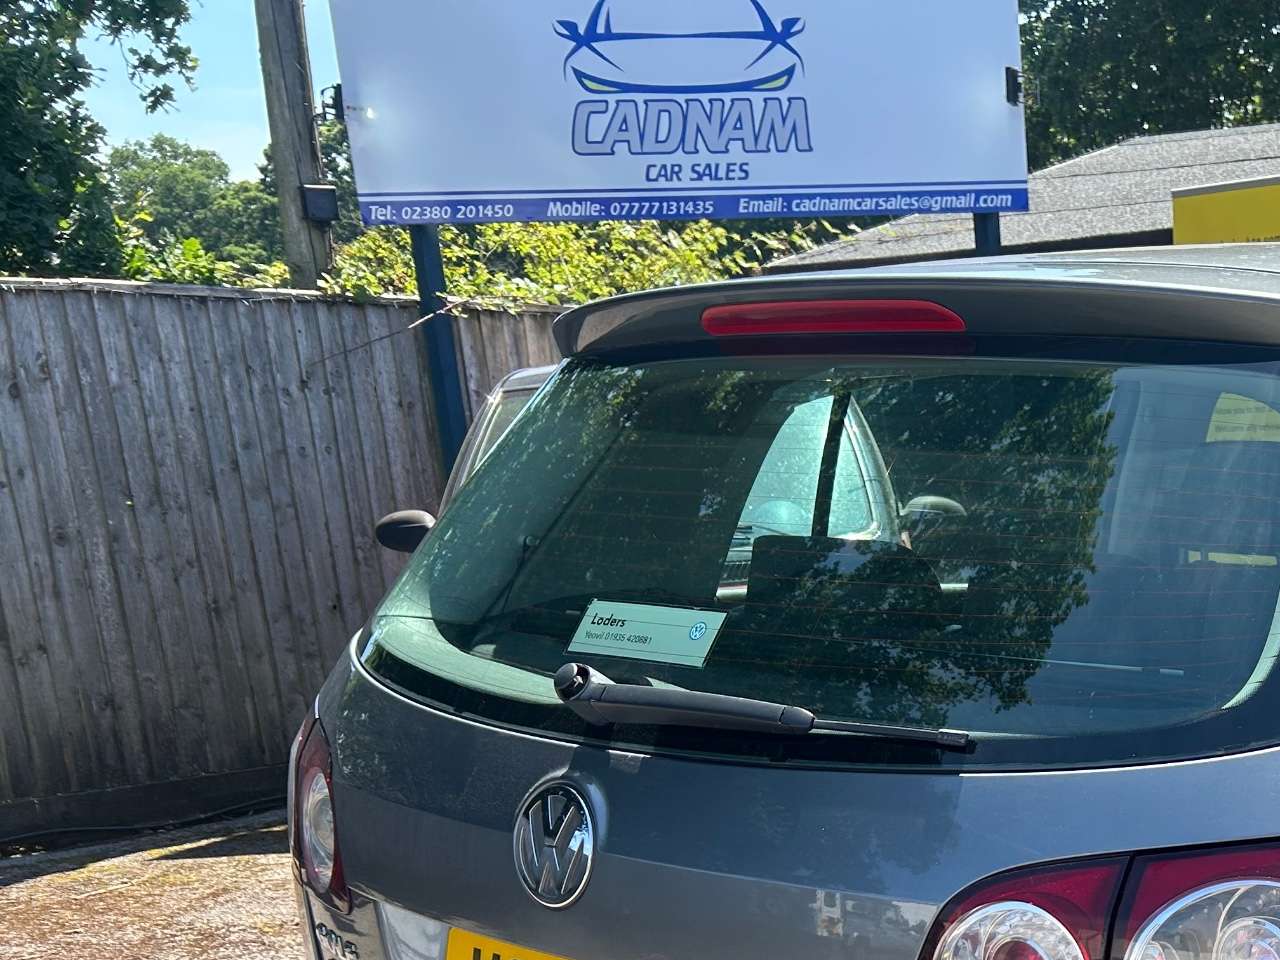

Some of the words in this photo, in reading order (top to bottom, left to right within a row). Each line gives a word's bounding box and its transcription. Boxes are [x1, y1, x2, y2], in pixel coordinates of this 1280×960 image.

[572, 97, 813, 156] CADNAM
[645, 164, 682, 182] CAR
[689, 162, 750, 181] SALES
[369, 205, 397, 220] Tel:
[401, 206, 451, 219] 02380
[456, 204, 514, 218] 201450
[547, 201, 606, 217] Mobile:
[610, 200, 714, 216] 07777131435
[739, 198, 787, 213] Email:
[792, 192, 1012, 212] cadnamcarsales@gmail.com
[591, 612, 626, 628] Loders
